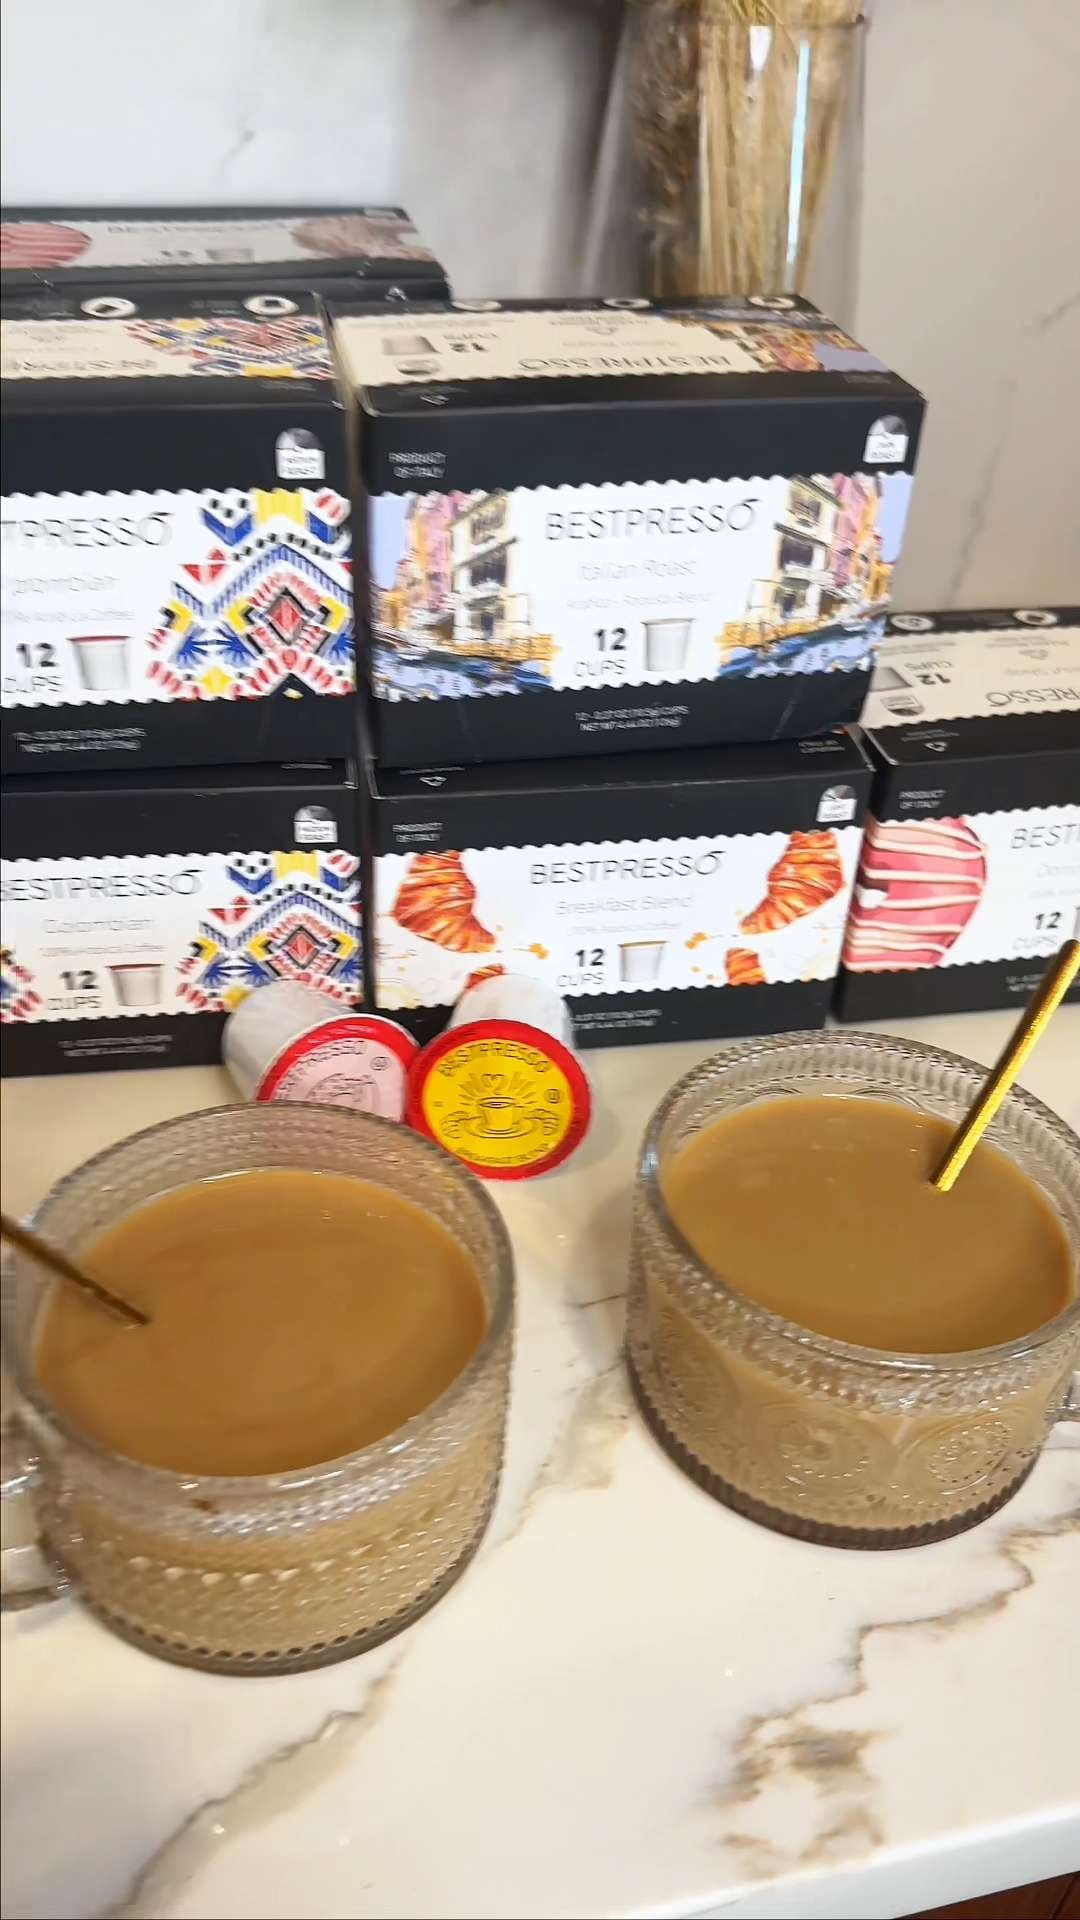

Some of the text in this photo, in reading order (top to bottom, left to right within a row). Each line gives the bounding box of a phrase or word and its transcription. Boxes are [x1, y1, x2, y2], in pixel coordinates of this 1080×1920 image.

[594, 627, 627, 651] 12
[16, 642, 56, 668] 12
[574, 658, 628, 678] CUPS
[916, 673, 951, 686] 12
[1034, 911, 1062, 930] 12
[575, 948, 605, 967] 12
[60, 970, 98, 990] 12
[556, 972, 604, 988] CUPS
[47, 995, 102, 1011] CUPS
